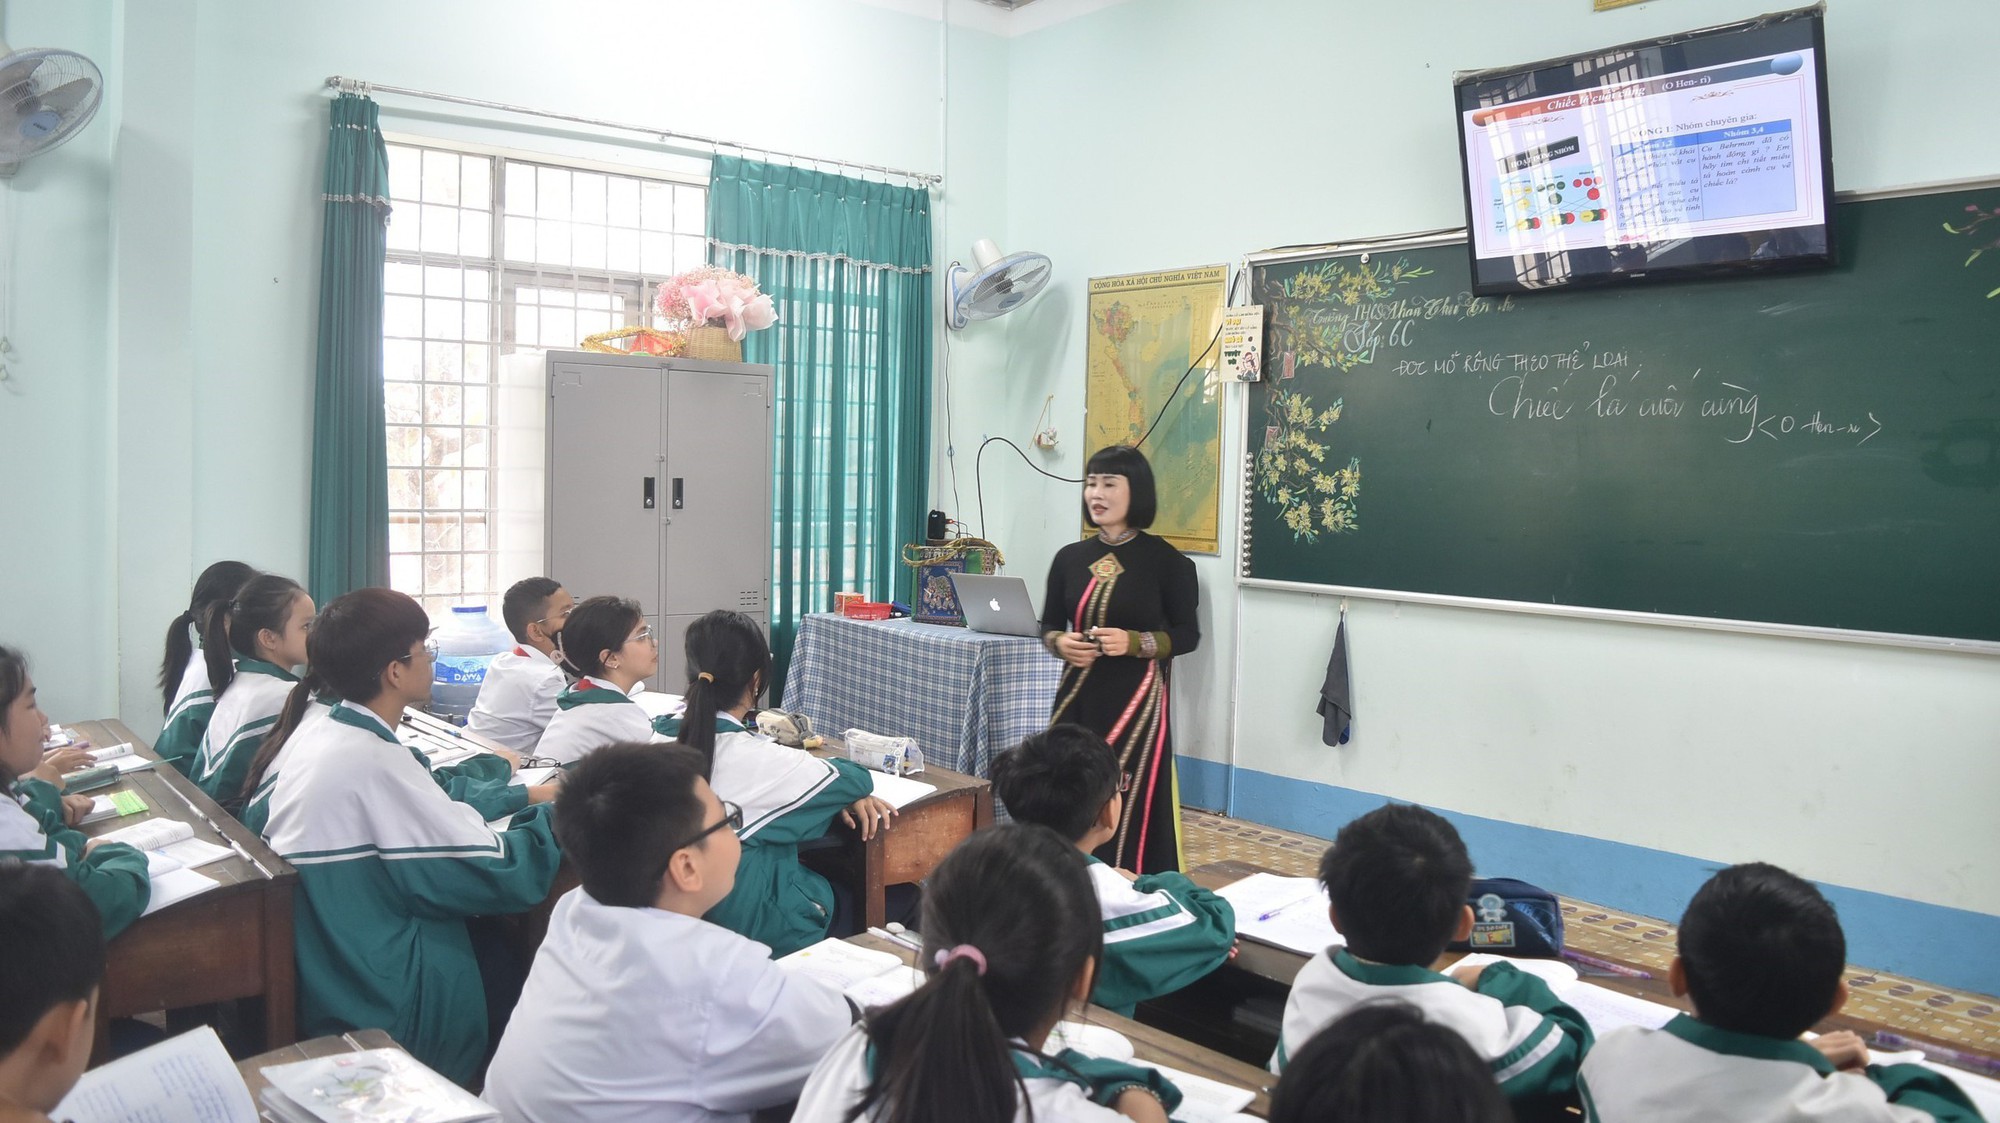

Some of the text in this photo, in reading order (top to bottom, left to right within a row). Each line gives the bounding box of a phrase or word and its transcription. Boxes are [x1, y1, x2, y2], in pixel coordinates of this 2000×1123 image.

[1547, 96, 1576, 110] Chiếc
[1675, 78, 1697, 89] Hen-
[1676, 122, 1703, 132] Nhóm
[1705, 117, 1737, 129] chuyên
[1740, 113, 1757, 123] gia:
[1723, 127, 1750, 138] Nhóm
[1093, 280, 1111, 290] CỘNG
[1111, 279, 1125, 288] HÒA
[1136, 277, 1148, 286] HỘI
[1149, 273, 1163, 284] CHỦ
[1163, 272, 1185, 283] NGHĨA
[1186, 271, 1203, 281] VIỆT
[1203, 270, 1220, 279] NAM
[1308, 307, 1349, 331] Trường
[1353, 303, 1384, 321] THCS
[1388, 318, 1416, 348] 6C
[1506, 352, 1549, 372] THEO
[1550, 341, 1590, 370] THỂ
[1488, 372, 1576, 421] Chiếc
[1585, 369, 1641, 418] lá
[1700, 381, 1759, 443] cùng
